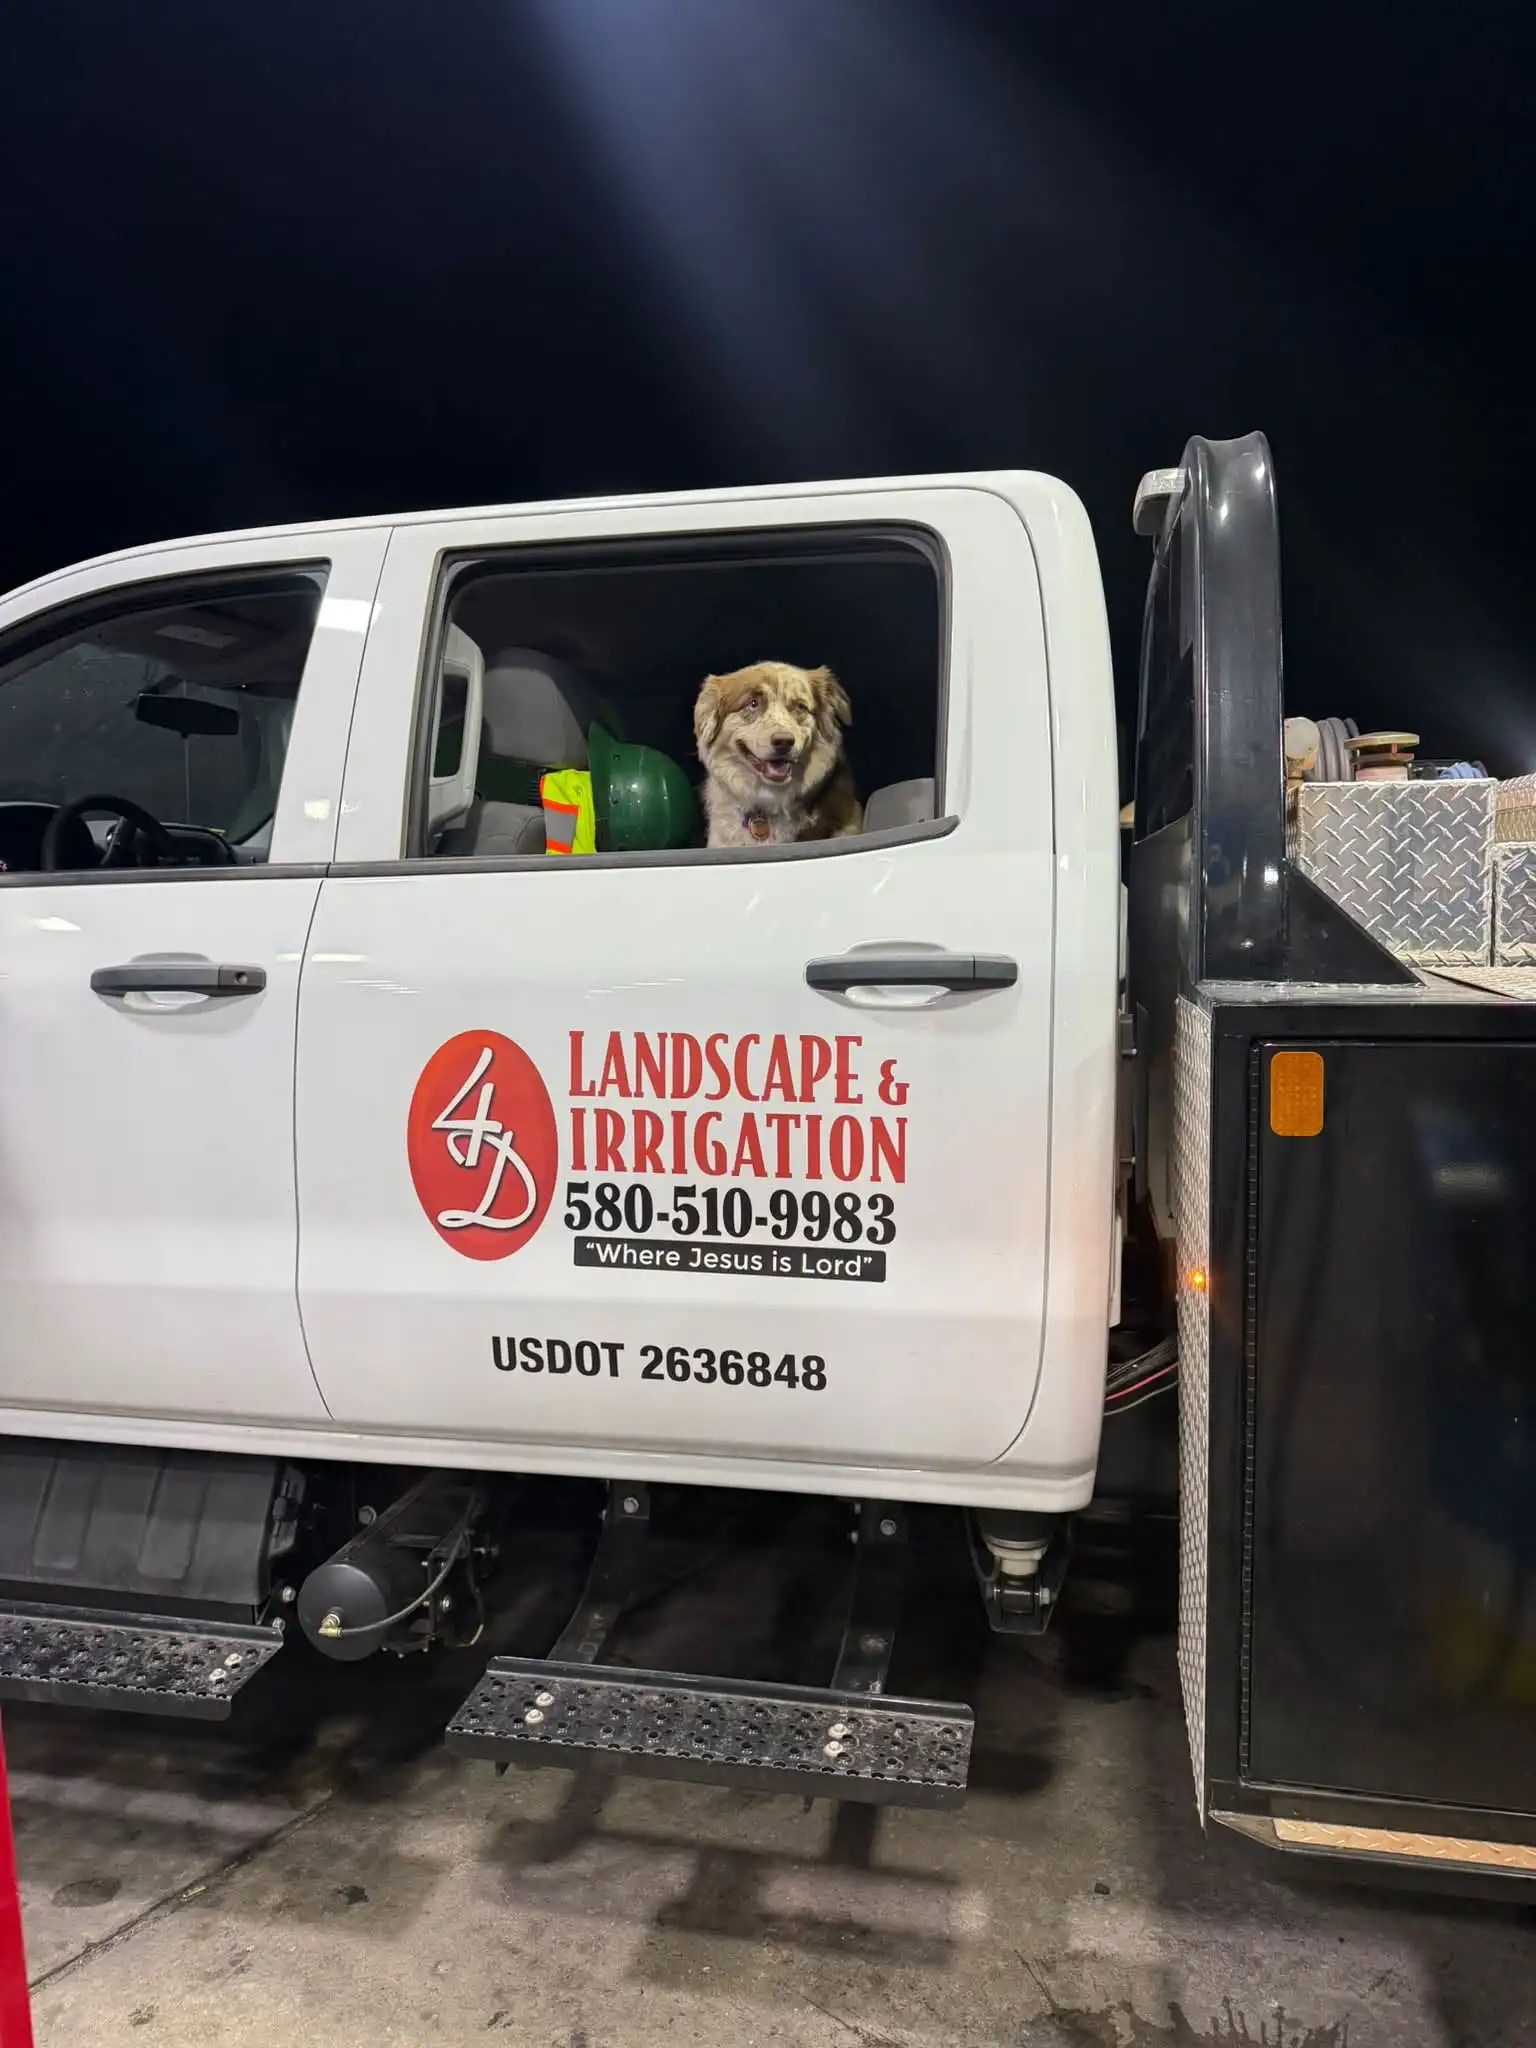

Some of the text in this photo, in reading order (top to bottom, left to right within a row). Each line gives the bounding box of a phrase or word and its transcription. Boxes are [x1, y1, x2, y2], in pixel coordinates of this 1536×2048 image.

[568, 1030, 909, 1106] LANDSCAPE &
[570, 1108, 908, 1183] IRRIGATION
[564, 1181, 897, 1244] 580-510-9983
[689, 1248, 763, 1272] Jesus
[772, 1251, 792, 1272] is
[492, 1336, 827, 1391] USDOT 2636848
